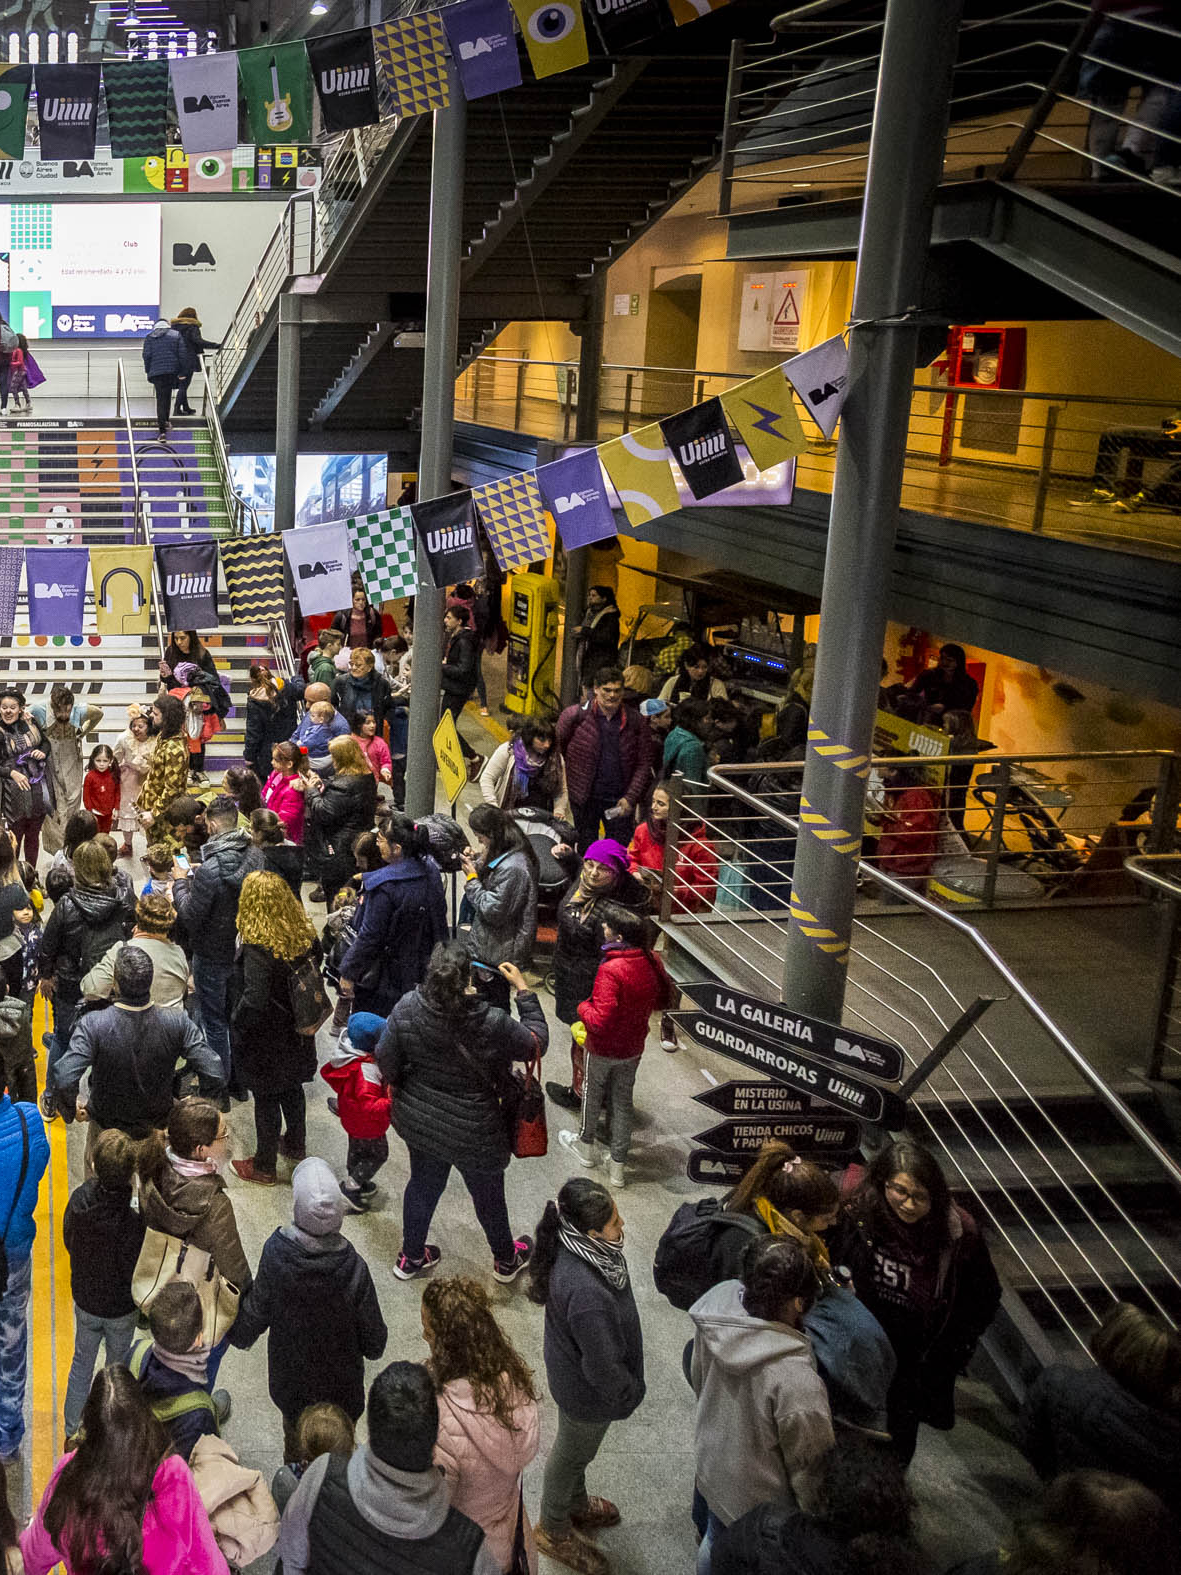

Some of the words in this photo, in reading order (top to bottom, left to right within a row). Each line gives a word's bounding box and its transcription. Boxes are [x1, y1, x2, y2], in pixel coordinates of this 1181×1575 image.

[459, 37, 491, 60] BA
[183, 95, 214, 113] BA
[63, 161, 94, 178] BA
[123, 240, 139, 248] Club
[173, 243, 216, 265] BA
[808, 382, 838, 406] BA
[555, 493, 585, 514] BA
[298, 561, 328, 579] BA
[35, 583, 64, 599] BA
[716, 994, 736, 1015] LA
[741, 1004, 813, 1043] GALERÍA
[835, 1038, 866, 1061] BA
[695, 1020, 817, 1084] GUARDARROPAS
[735, 1088, 788, 1099] MISTERIO
[734, 1100, 749, 1110] EN
[751, 1100, 765, 1110] LA
[769, 1100, 802, 1111] USINA
[733, 1126, 771, 1136] TIENDA
[774, 1124, 813, 1135] CHICOS
[733, 1138, 738, 1148] Y
[699, 1160, 727, 1175] BA
